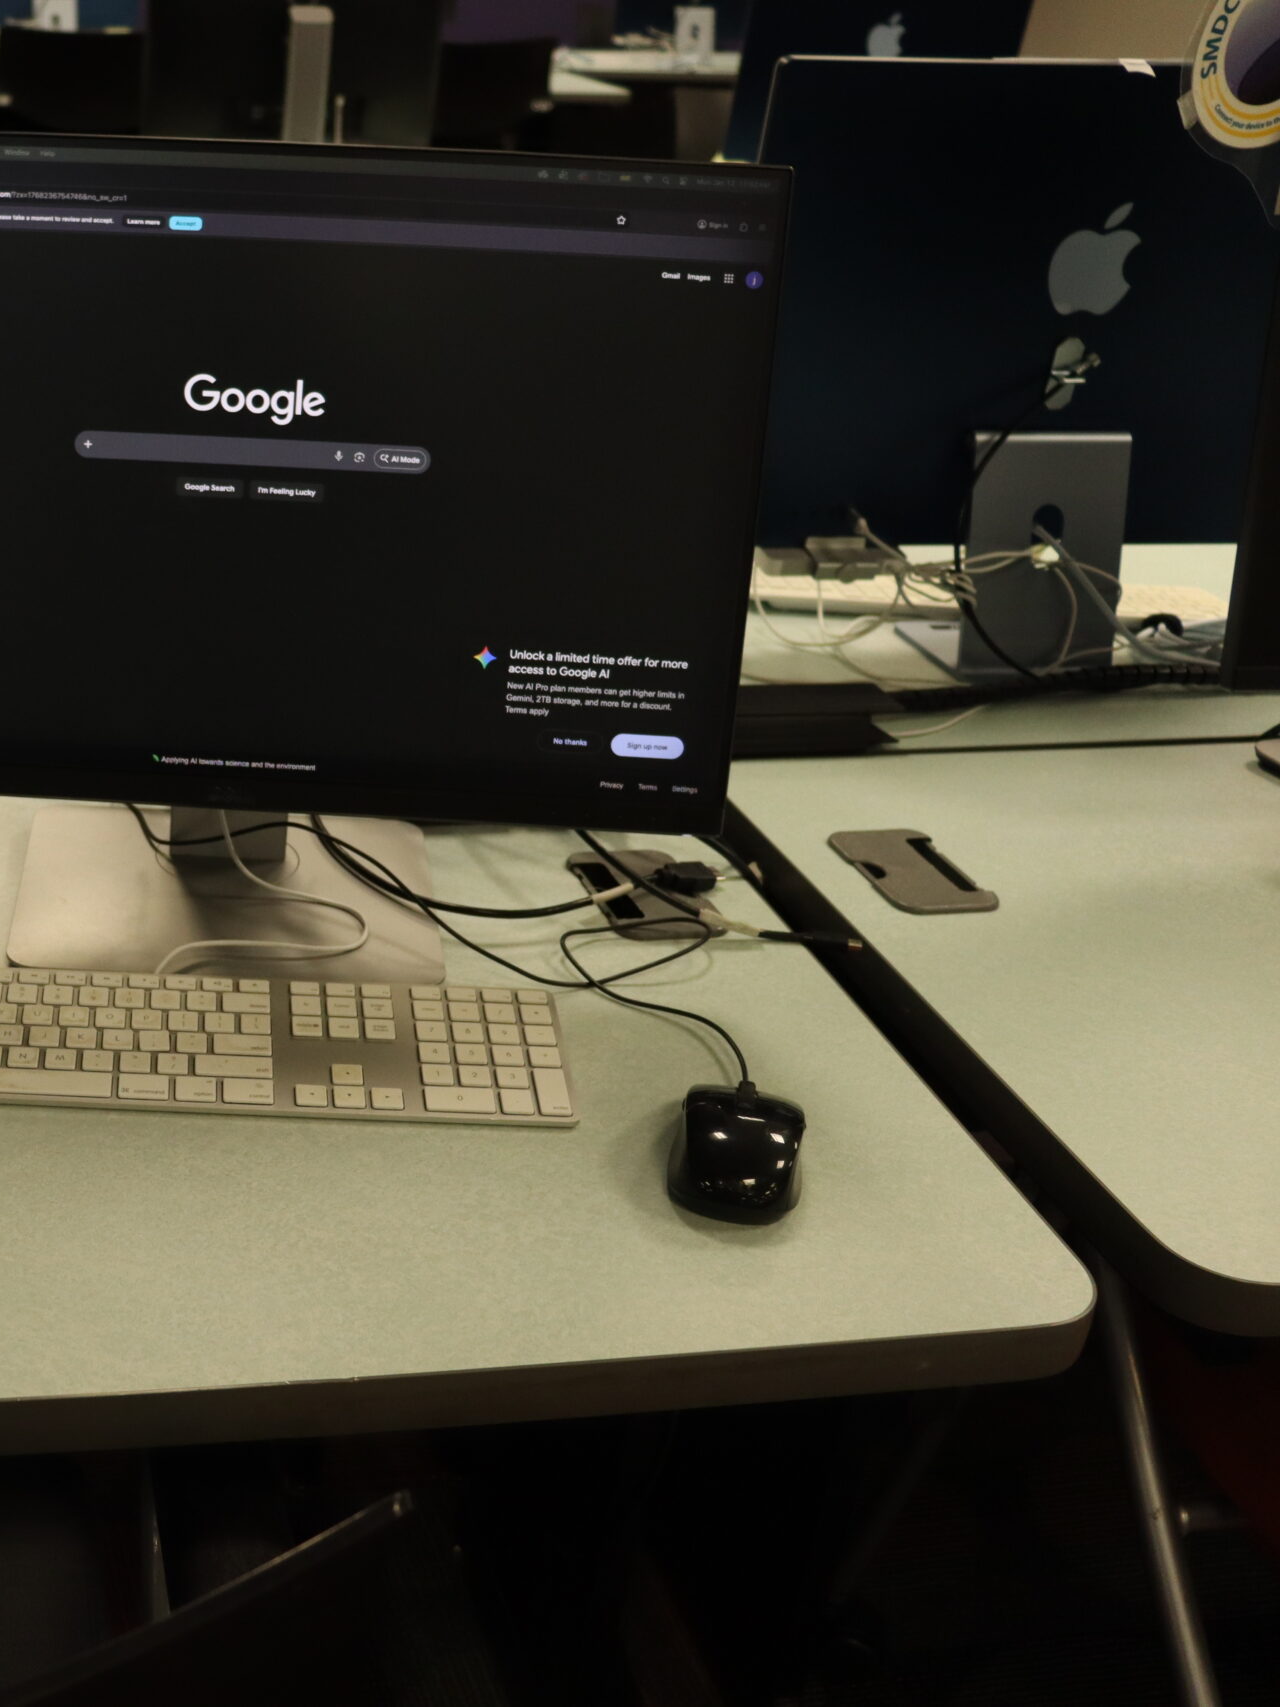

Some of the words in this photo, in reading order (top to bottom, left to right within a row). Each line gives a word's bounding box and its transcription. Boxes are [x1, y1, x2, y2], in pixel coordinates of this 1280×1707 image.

[1201, 0, 1240, 79] SMDC
[4, 149, 31, 157] Window
[175, 220, 197, 228] Accept
[661, 271, 681, 280] Gmail
[687, 272, 712, 283] Images
[183, 372, 326, 426] Google
[391, 455, 399, 464] AI
[400, 455, 421, 465] Mode
[184, 482, 210, 494] Google
[211, 483, 235, 493] Search
[258, 486, 268, 496] I'm
[269, 486, 294, 498] Feeling
[294, 487, 316, 498] Lucky
[509, 648, 545, 661] Unlock
[546, 653, 553, 662] a
[555, 651, 590, 664] limited
[592, 653, 615, 665] time
[617, 655, 642, 667] offer
[644, 656, 658, 668] for
[661, 660, 689, 670] more
[508, 665, 544, 675] access
[546, 665, 557, 676] to
[559, 666, 597, 680] Google
[598, 668, 610, 679] AI
[506, 681, 524, 690] New
[525, 682, 534, 691] AI
[535, 683, 549, 692] Pro
[550, 683, 567, 693] plan
[567, 685, 602, 694] members
[604, 687, 617, 695] can
[619, 687, 631, 698] get
[632, 688, 656, 699] higher
[657, 689, 676, 699] limits
[506, 693, 534, 703] Gemini,
[535, 695, 552, 704] 2TB
[553, 696, 583, 707] storage,
[584, 697, 599, 706] and
[600, 700, 620, 708] more
[621, 699, 631, 708] for
[639, 700, 672, 711] discount.
[505, 705, 527, 715] Terms
[529, 706, 550, 717] apply
[552, 736, 563, 746] No
[564, 737, 588, 747] thanks
[626, 742, 642, 751] Sign
[643, 743, 652, 752] up
[161, 756, 189, 766] Applying
[198, 758, 223, 766] towards
[225, 759, 250, 767] science
[251, 760, 263, 768] and
[264, 761, 275, 769] the
[276, 762, 316, 771] environment
[600, 780, 624, 790] Privacy
[638, 782, 658, 792] Terms
[672, 784, 699, 795] Settings
